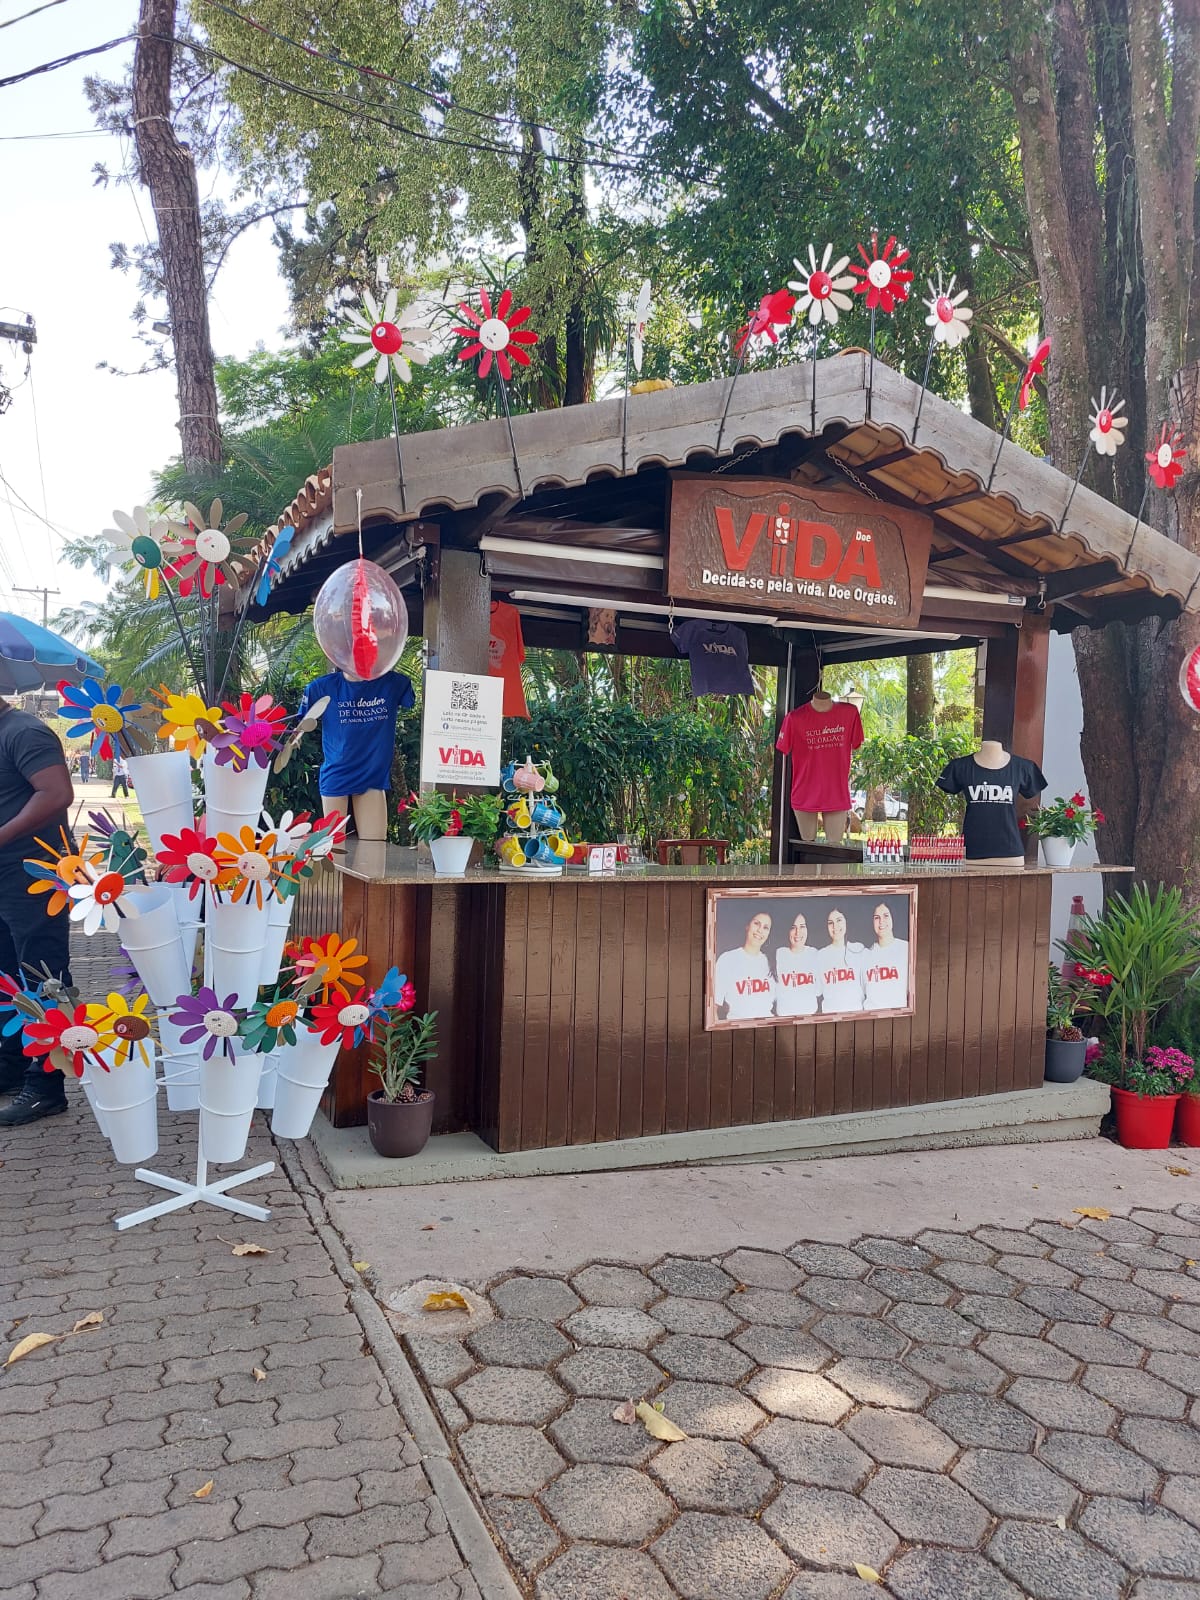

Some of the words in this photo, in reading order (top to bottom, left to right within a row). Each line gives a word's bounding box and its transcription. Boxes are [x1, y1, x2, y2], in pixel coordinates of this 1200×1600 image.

[855, 530, 872, 543] Doe
[702, 569, 764, 590] Decida-se
[767, 578, 794, 594] pela
[797, 582, 825, 598] vida.
[828, 584, 851, 601] Doe
[853, 587, 897, 606] Orgãos.
[339, 709, 351, 717] DE
